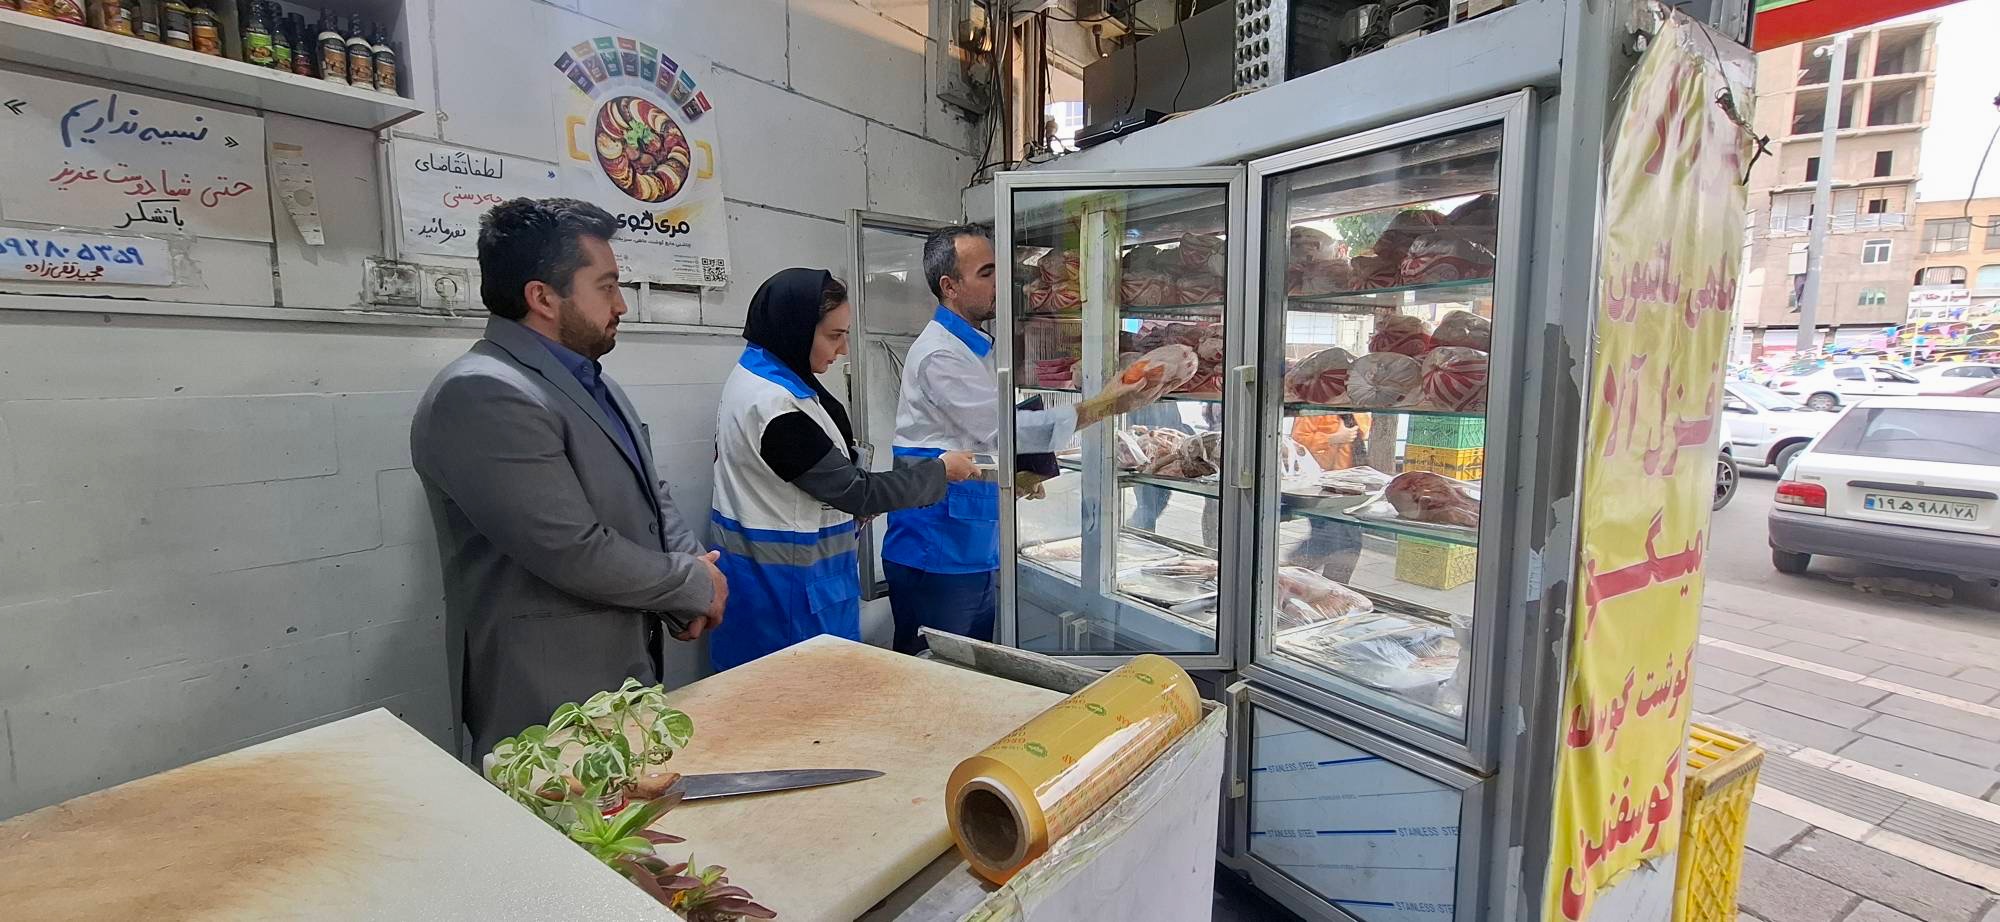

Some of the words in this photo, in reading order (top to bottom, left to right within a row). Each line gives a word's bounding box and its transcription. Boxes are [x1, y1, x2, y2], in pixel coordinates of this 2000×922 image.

[61, 93, 139, 148] نداریم
[140, 116, 208, 145] نسیه
[49, 161, 98, 191] عزیز
[103, 163, 157, 196] دوست
[162, 169, 192, 197] شما
[200, 176, 253, 208] حتی
[1583, 506, 1703, 640] میگو
[1636, 642, 1694, 719] گوشت
[1567, 665, 1635, 752] گوسله
